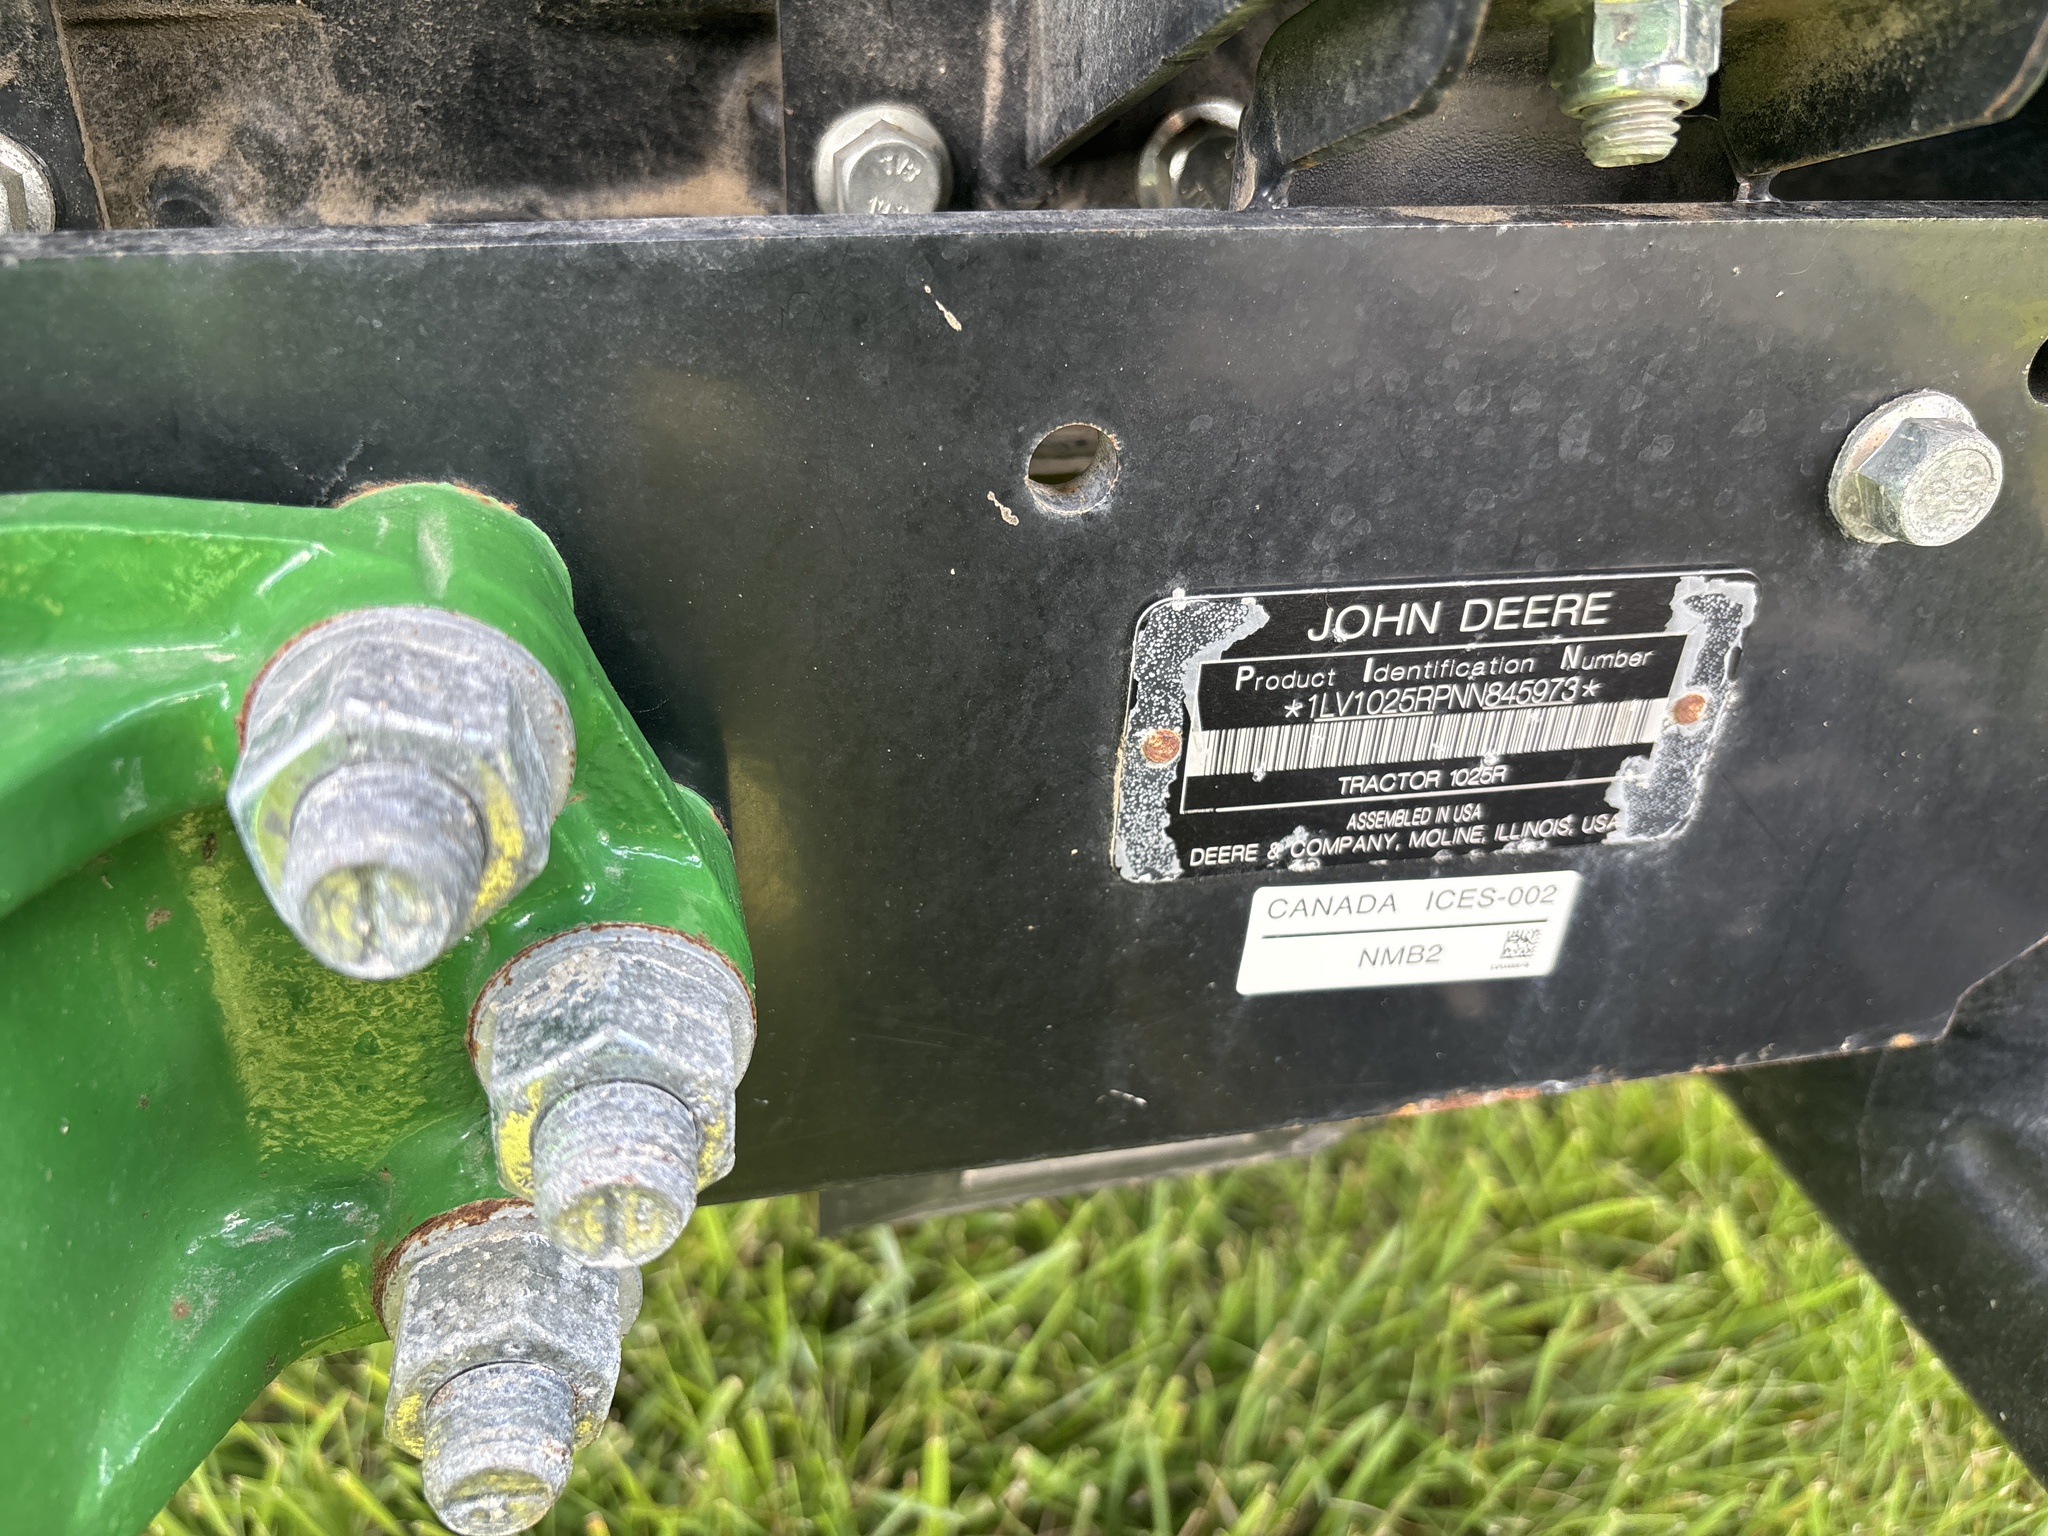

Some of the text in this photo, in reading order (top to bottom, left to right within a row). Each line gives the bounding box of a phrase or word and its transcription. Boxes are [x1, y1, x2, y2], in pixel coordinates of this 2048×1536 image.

[1307, 591, 1616, 642] JOHN DEERE
[1235, 643, 1655, 692] Product Identification Number
[1338, 763, 1510, 796] TRACTOR 1025R
[1346, 802, 1484, 831] ASSEMBLED IN USA
[1189, 842, 1260, 868] DEERE
[1266, 840, 1282, 860] &
[1267, 884, 1558, 920] CANADA ICES-002
[1357, 943, 1443, 970] NMB2
